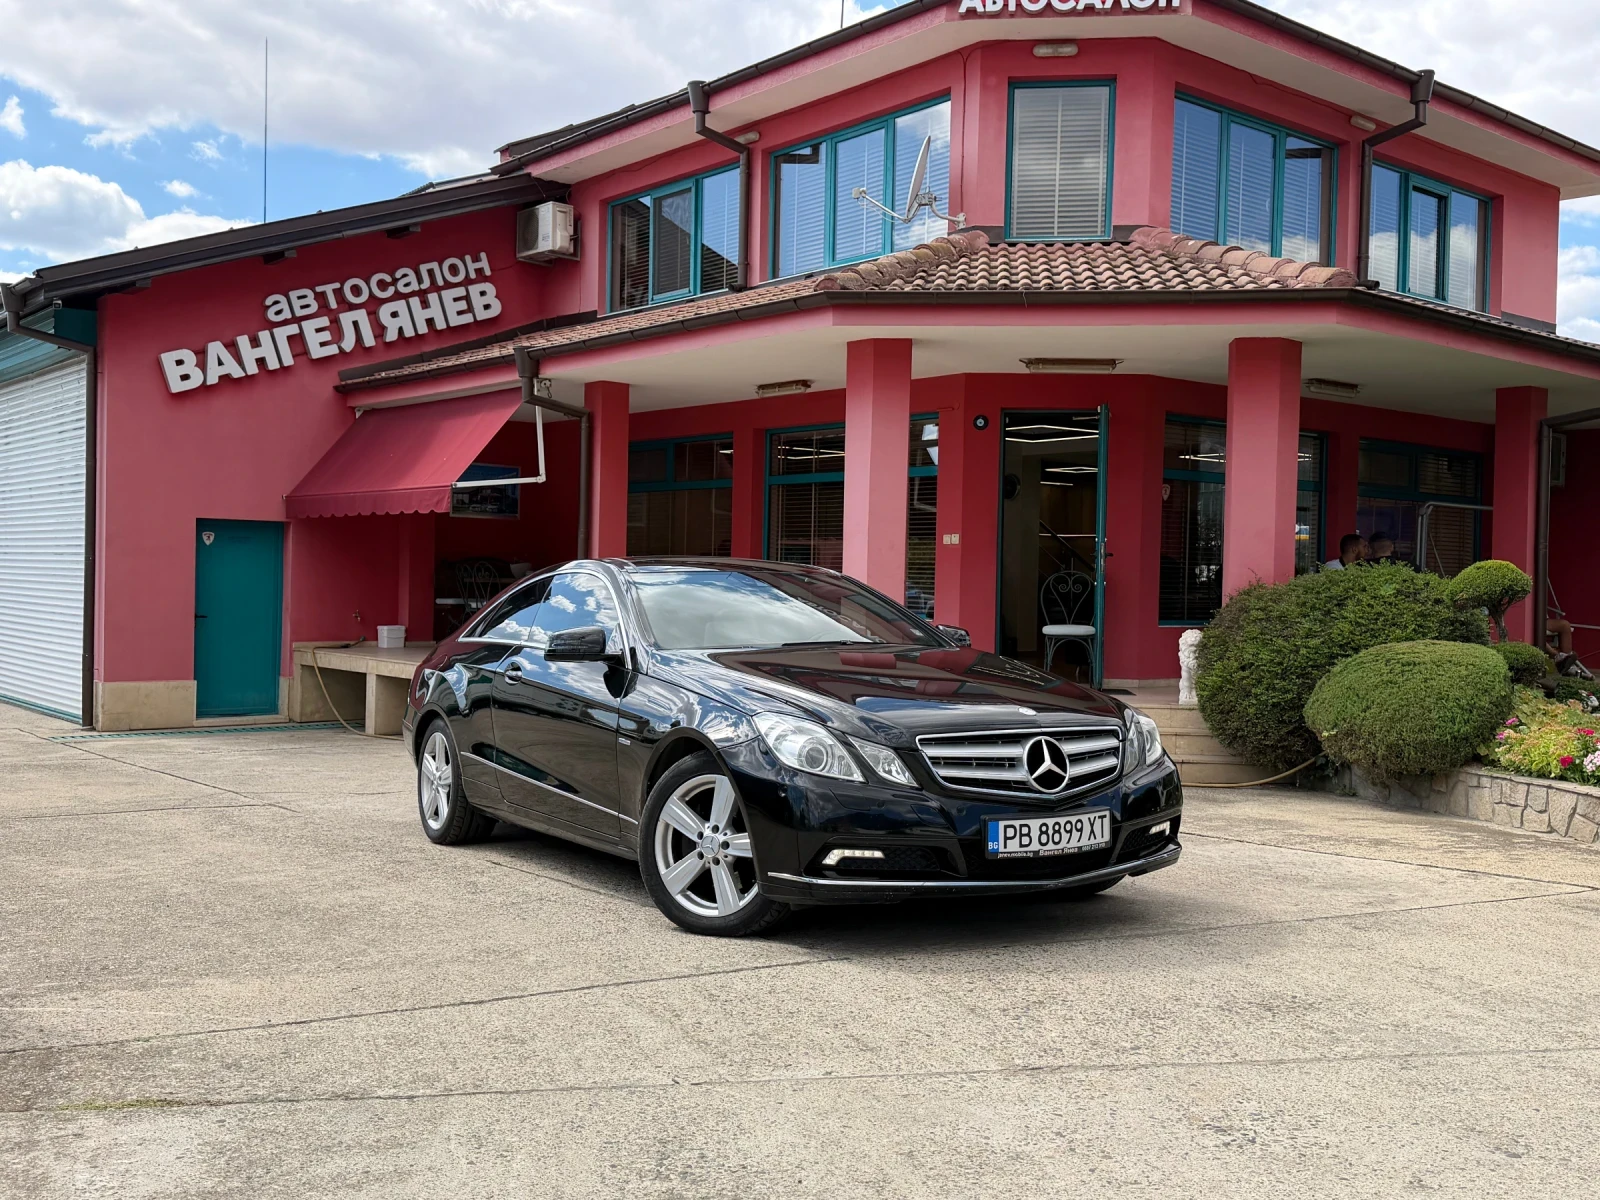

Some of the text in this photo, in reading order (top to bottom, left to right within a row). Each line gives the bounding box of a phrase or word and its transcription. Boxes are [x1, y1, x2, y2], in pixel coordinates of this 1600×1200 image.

[264, 252, 492, 322] автосалон
[159, 282, 502, 394] ВАНГЕЛ ЯНЕВ
[988, 841, 998, 850] BG
[1003, 814, 1107, 850] PB 8899 XT
[1039, 848, 1062, 856] Вангел
